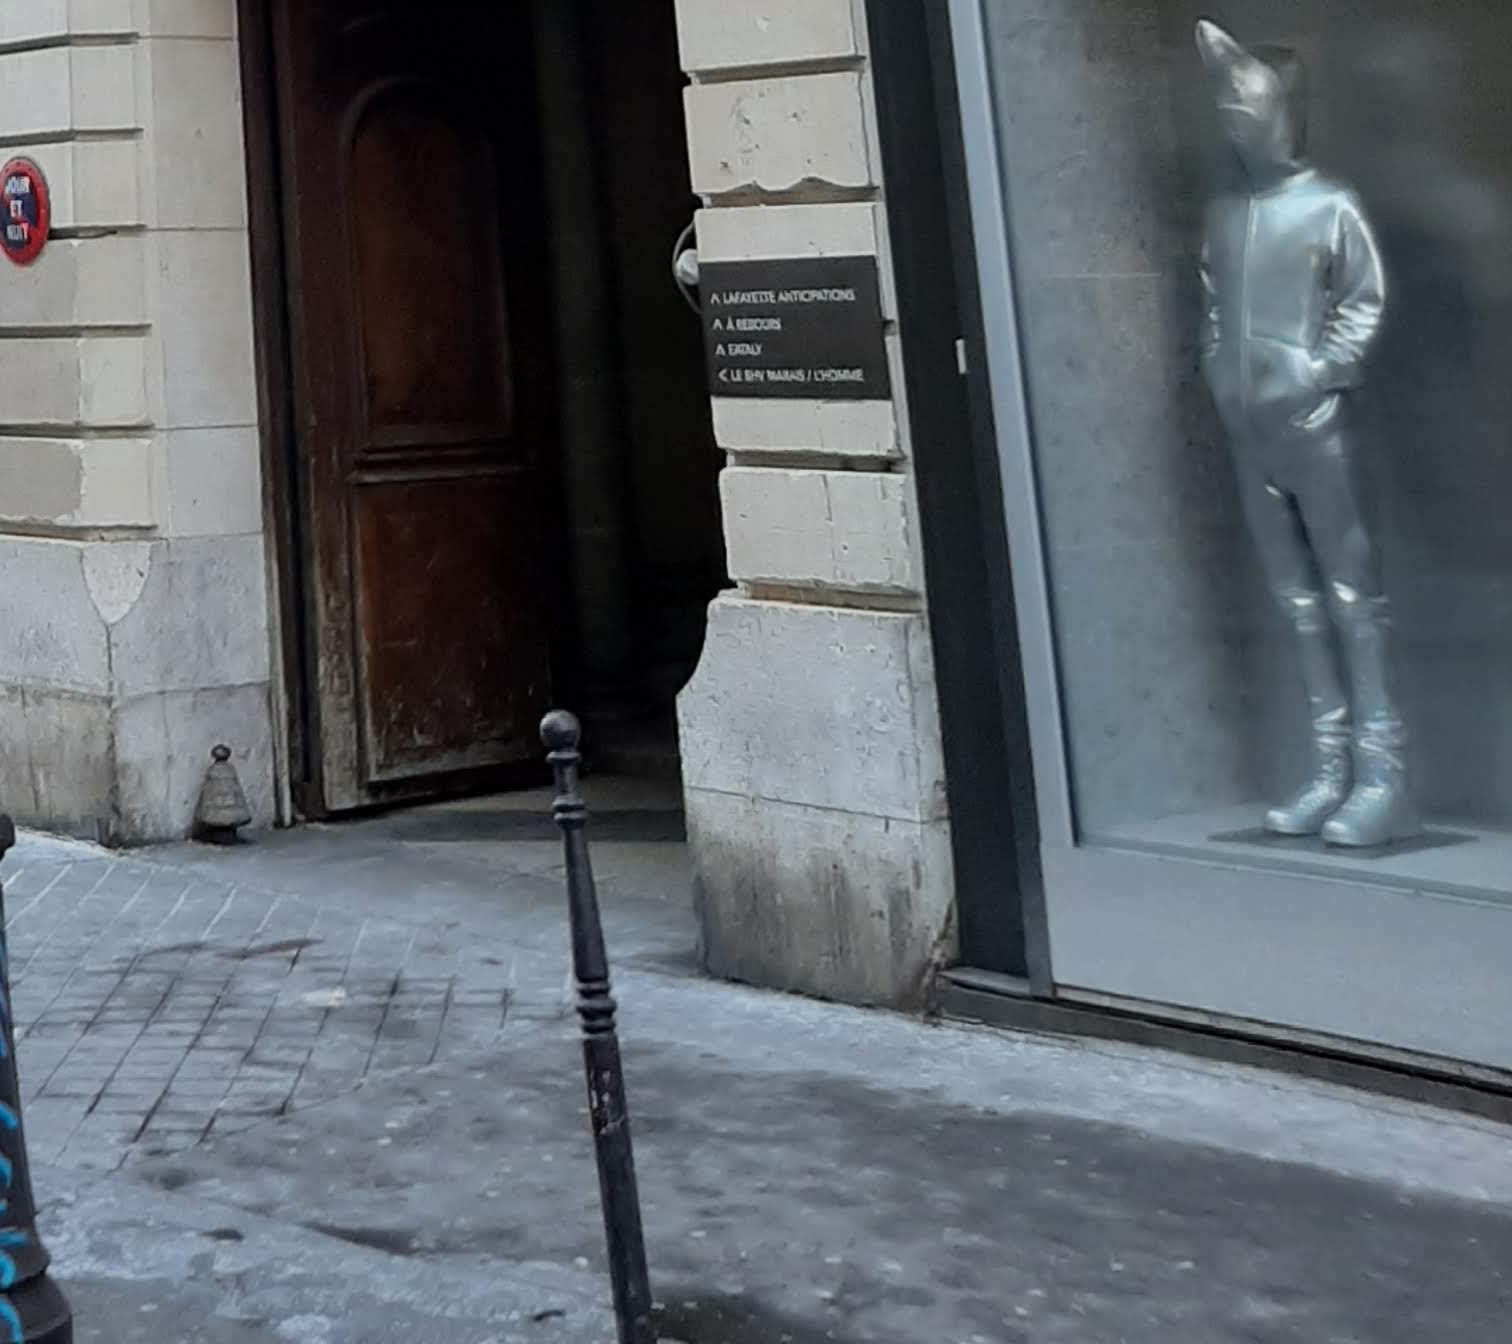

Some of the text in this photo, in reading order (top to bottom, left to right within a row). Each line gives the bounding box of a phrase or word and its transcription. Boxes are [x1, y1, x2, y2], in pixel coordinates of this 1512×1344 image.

[722, 288, 856, 304] LAFAYETTE ANTICIPATIONS
[730, 369, 742, 381] LE
[744, 369, 764, 381] BHV
[766, 369, 805, 382] MARAIS
